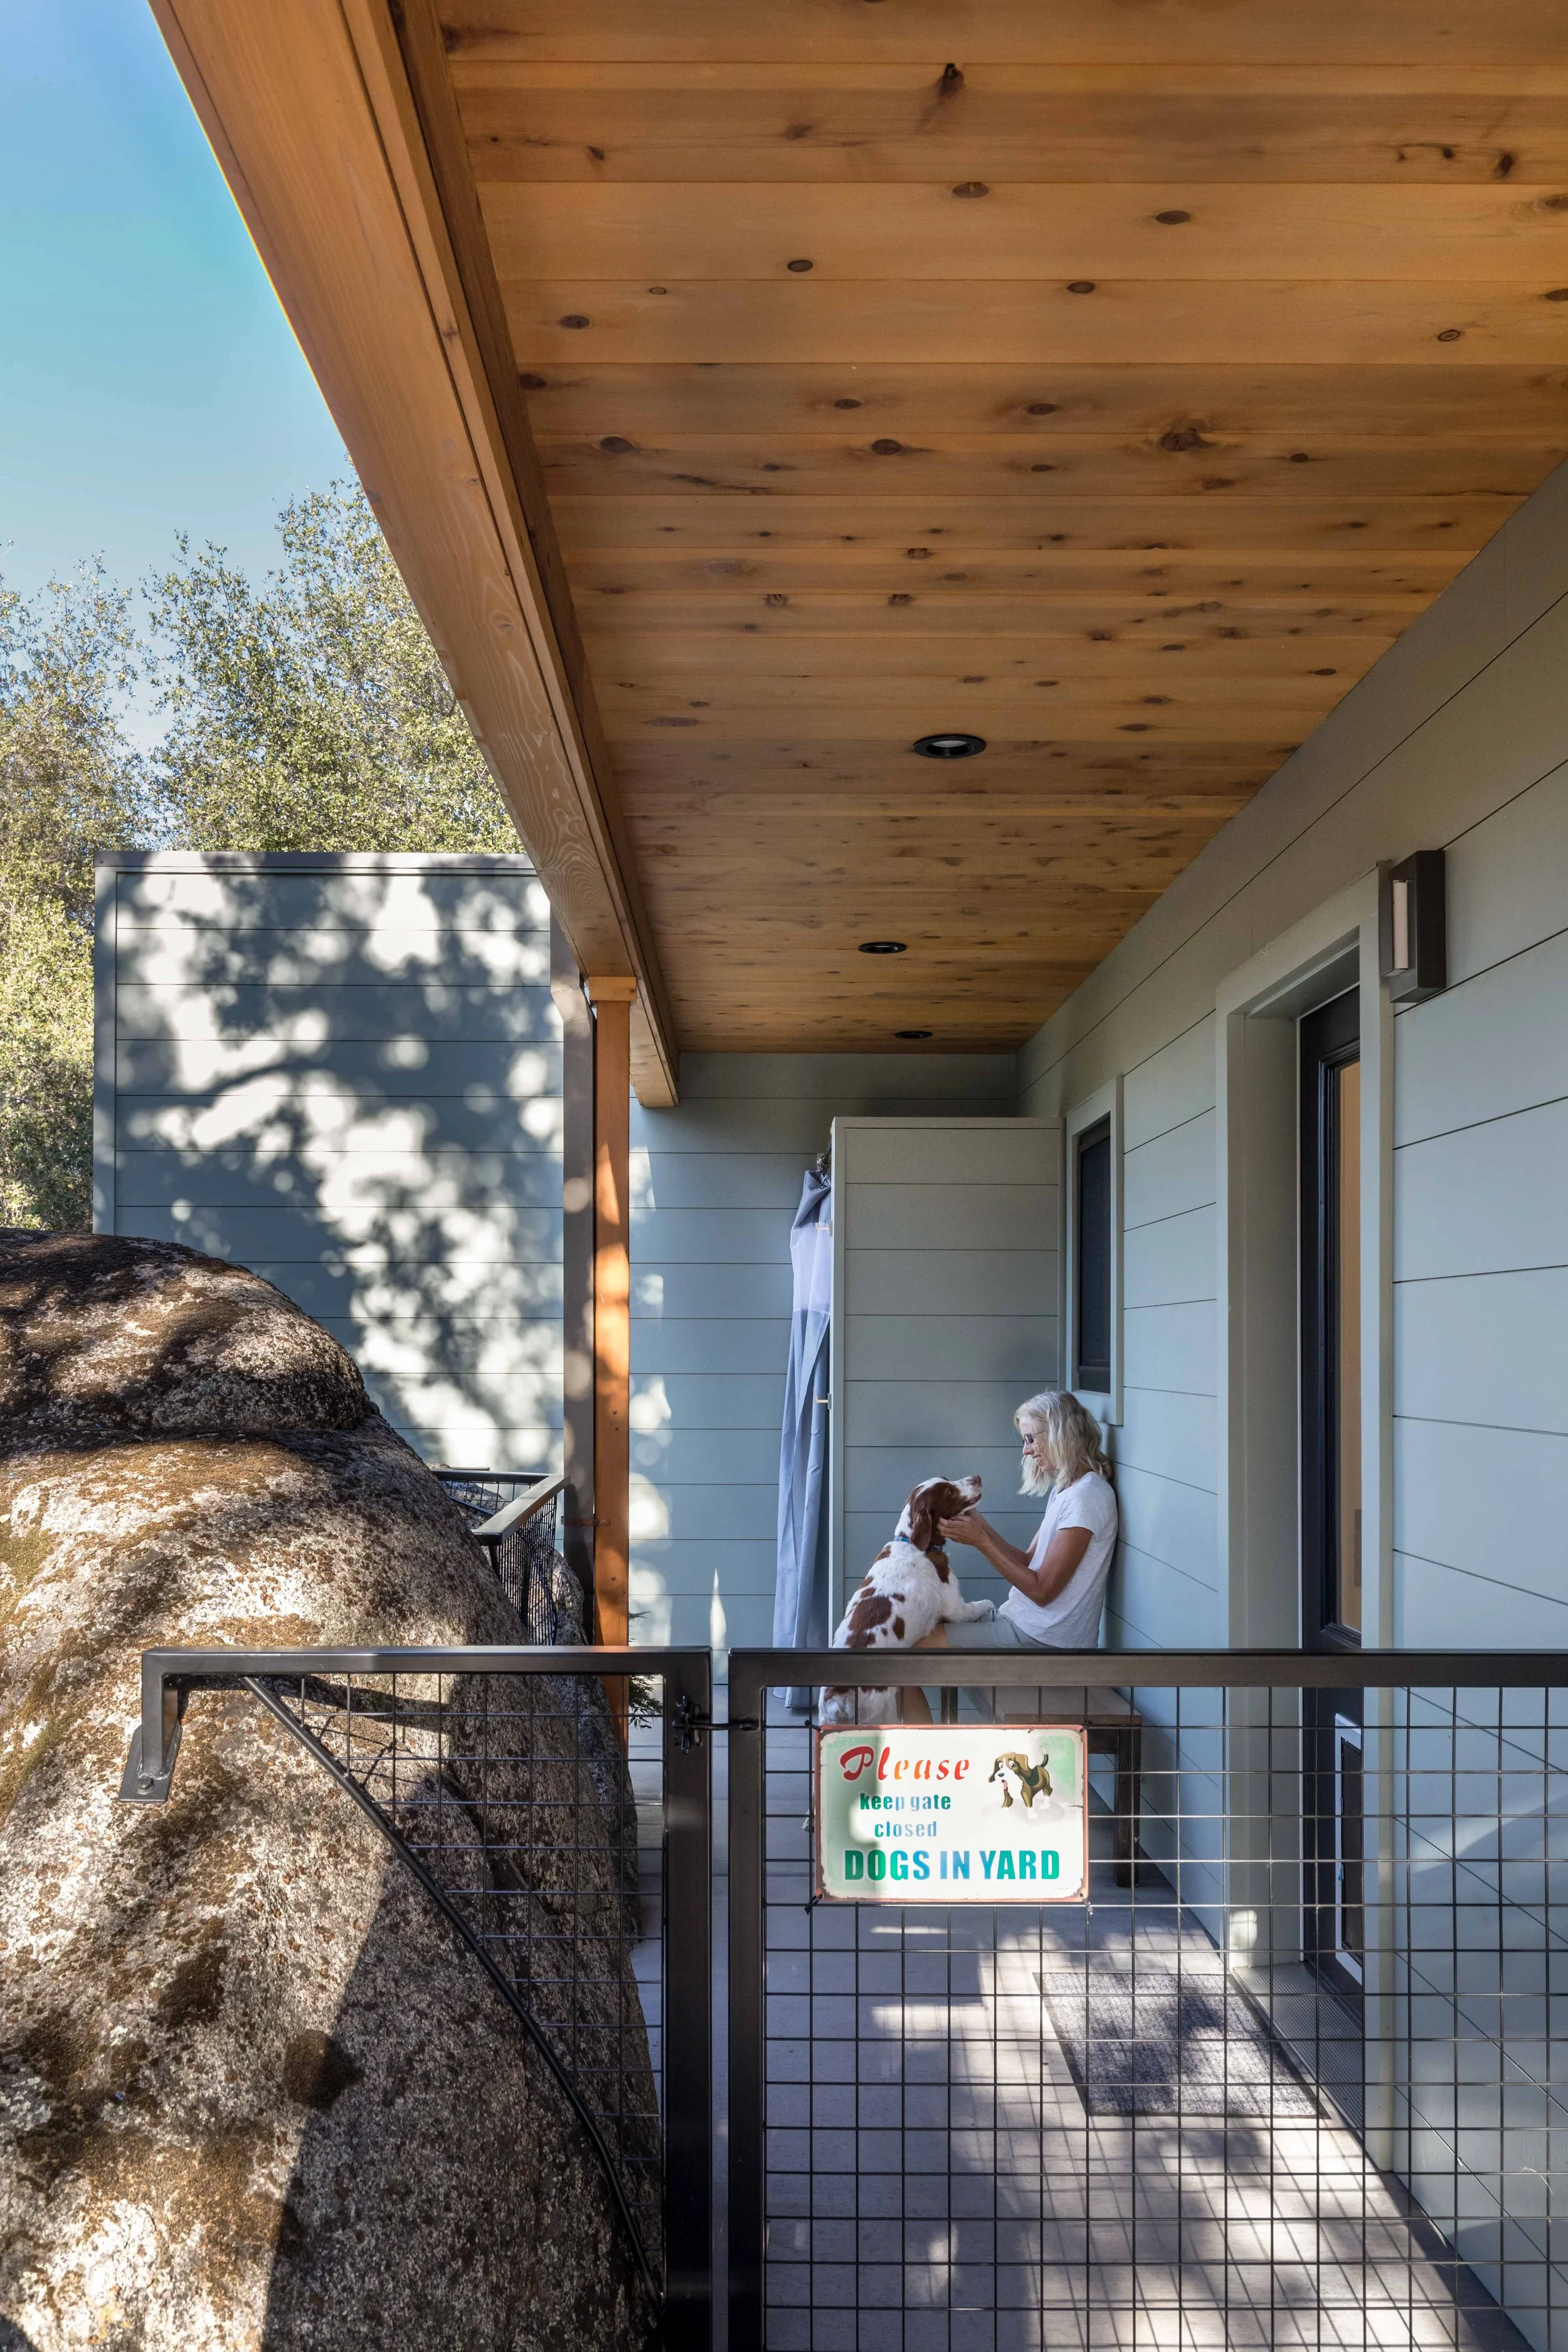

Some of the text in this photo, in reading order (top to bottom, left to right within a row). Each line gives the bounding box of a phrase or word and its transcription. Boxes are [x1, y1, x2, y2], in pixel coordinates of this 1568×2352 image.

[840, 1746, 970, 1780] Please
[860, 1793, 951, 1811] keep gate
[874, 1821, 937, 1837] closed
[845, 1850, 1059, 1880] DOGS IN YARD
